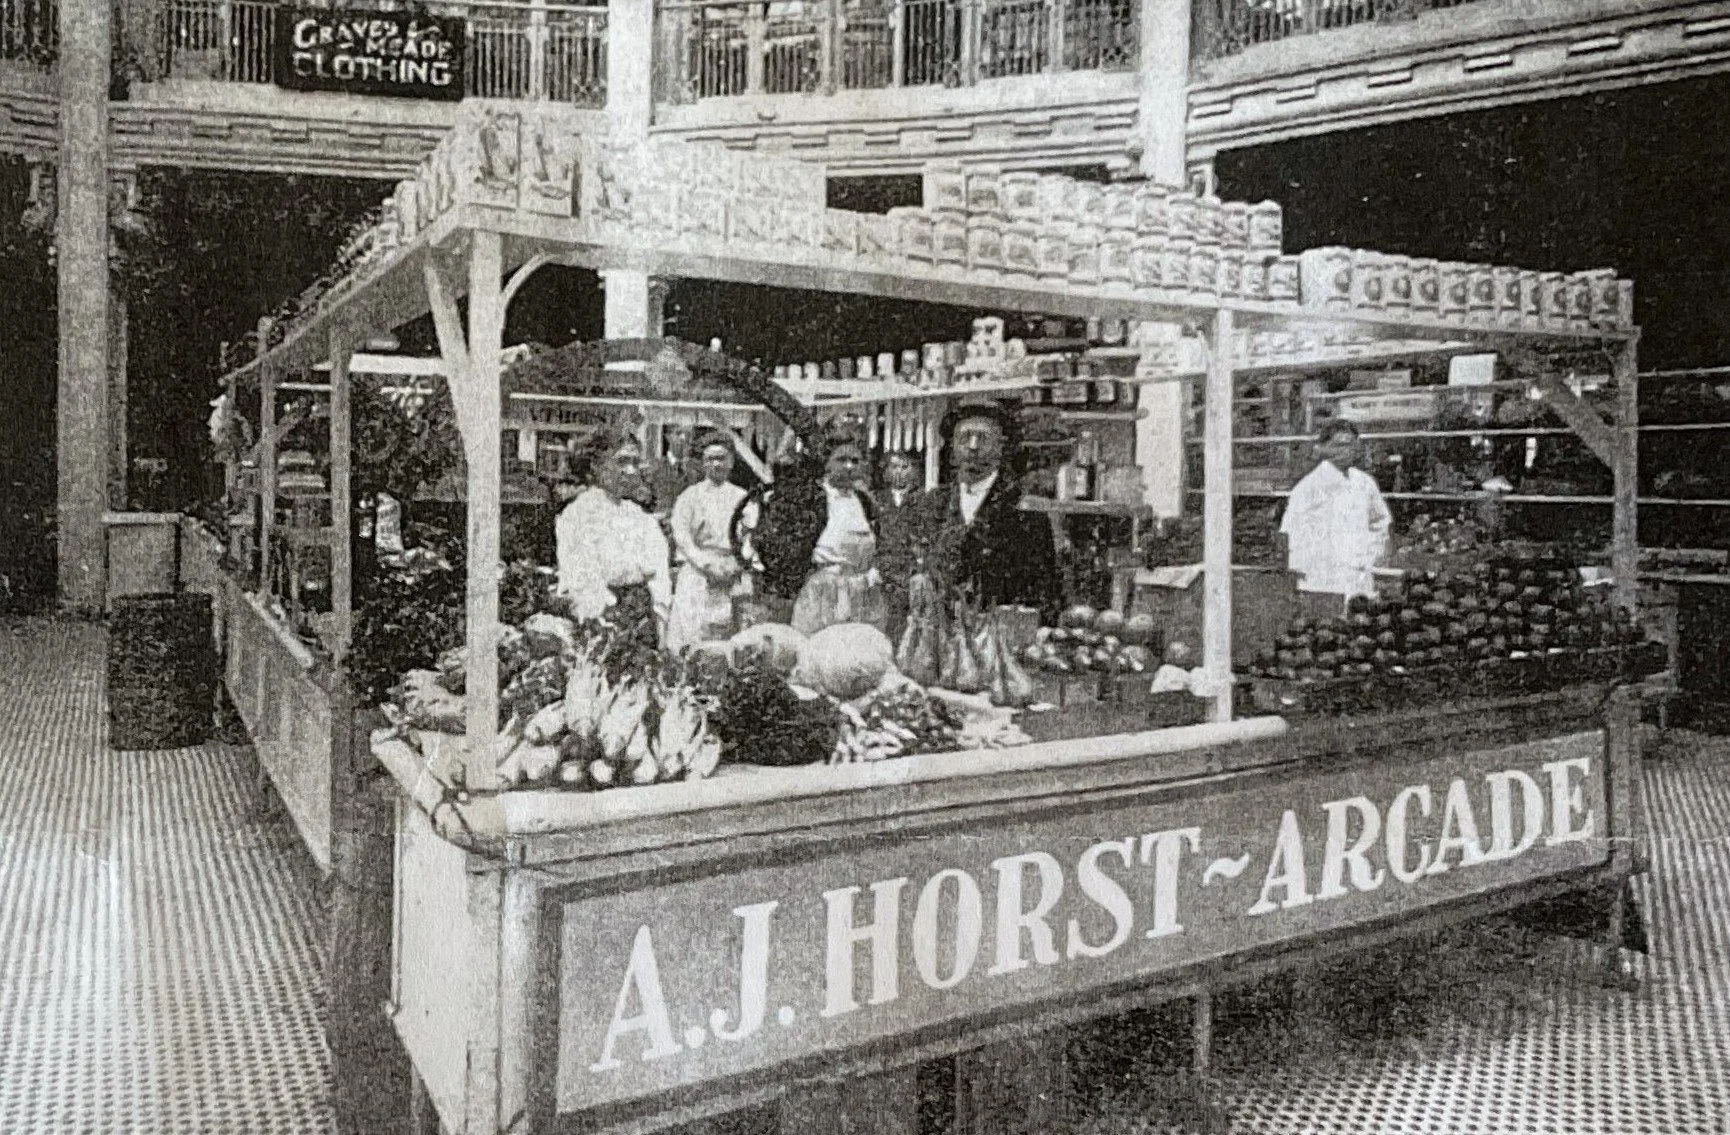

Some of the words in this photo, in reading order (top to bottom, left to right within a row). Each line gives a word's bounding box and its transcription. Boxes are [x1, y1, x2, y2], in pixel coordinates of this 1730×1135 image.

[293, 52, 451, 87] CLOTHING
[820, 827, 1201, 1018] HORST
[1248, 757, 1595, 916] ARCADE
